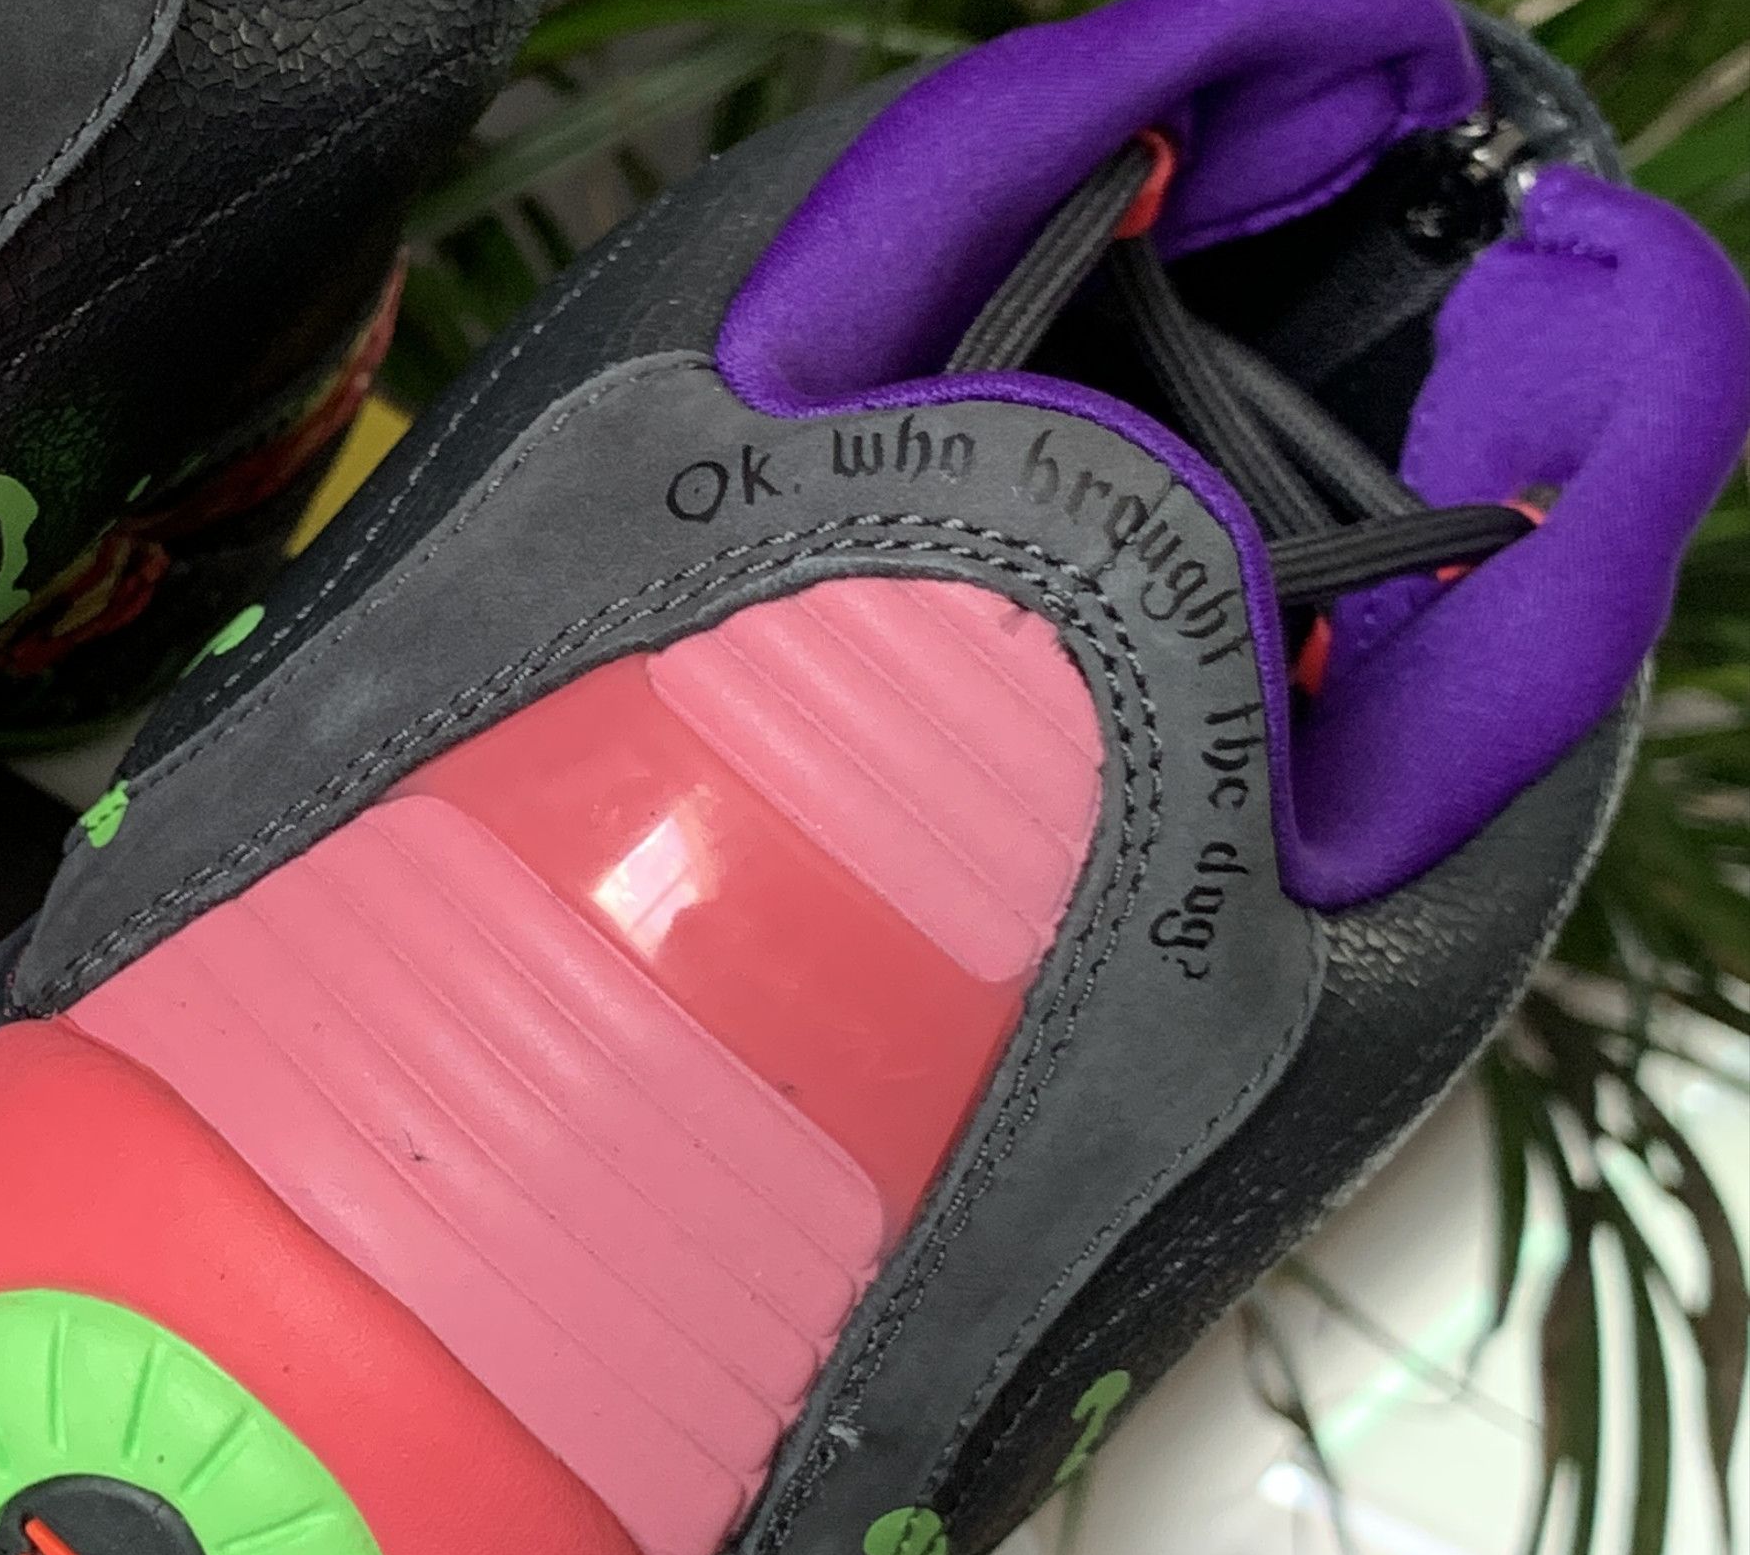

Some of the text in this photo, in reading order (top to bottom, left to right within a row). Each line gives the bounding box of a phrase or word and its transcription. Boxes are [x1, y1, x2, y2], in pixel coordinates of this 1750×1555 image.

[831, 413, 977, 485] who
[1021, 428, 1250, 666] brought
[1201, 701, 1265, 811] the
[1149, 841, 1250, 980] dog?
